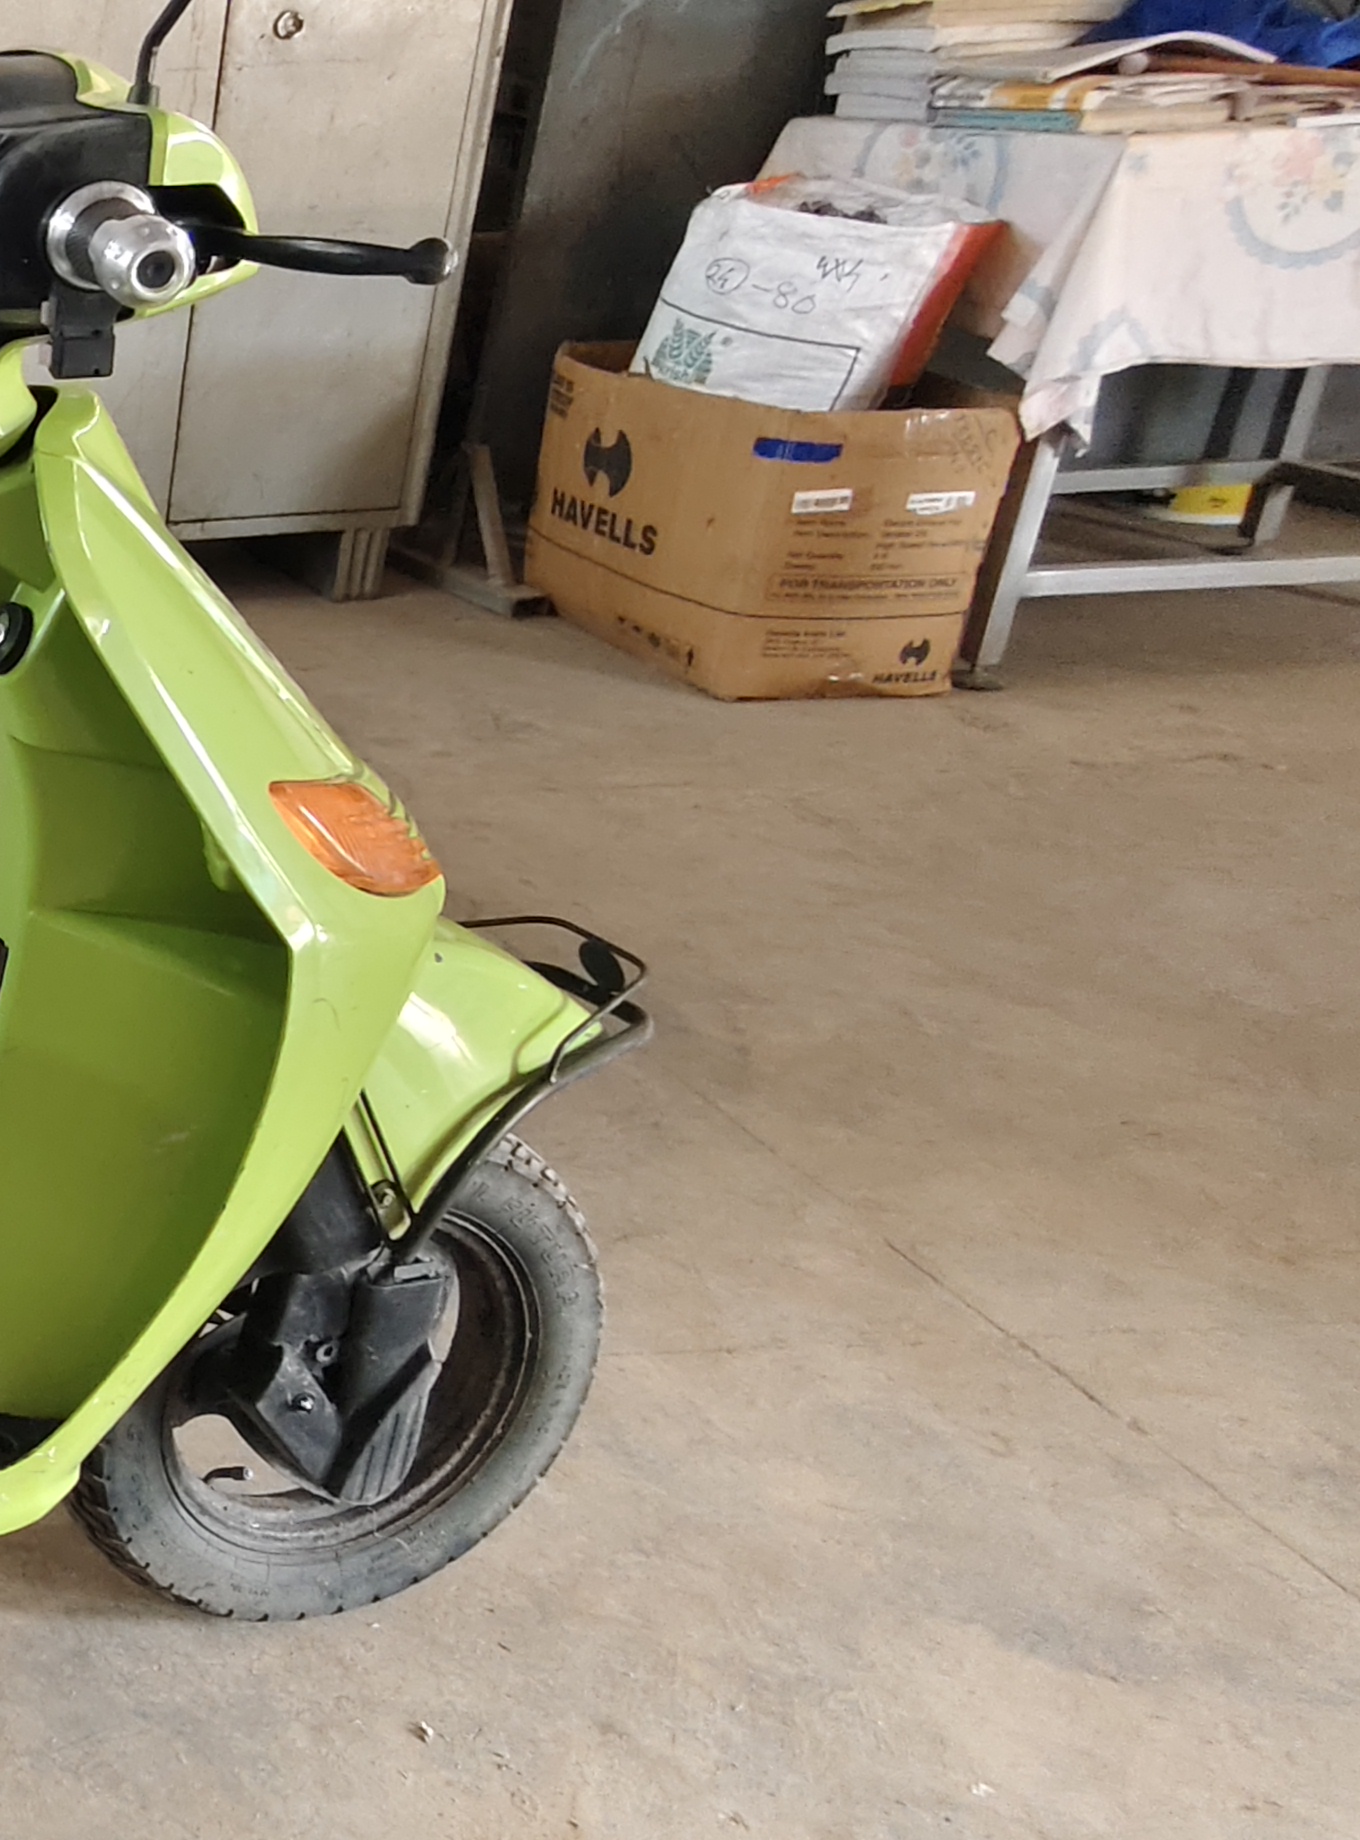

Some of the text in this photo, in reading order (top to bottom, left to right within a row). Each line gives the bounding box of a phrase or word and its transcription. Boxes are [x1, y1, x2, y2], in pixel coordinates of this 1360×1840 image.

[550, 487, 658, 556] HAVELLS
[780, 578, 809, 588] FOR
[928, 578, 957, 588] ONLY
[871, 669, 938, 685] HAVELLS
